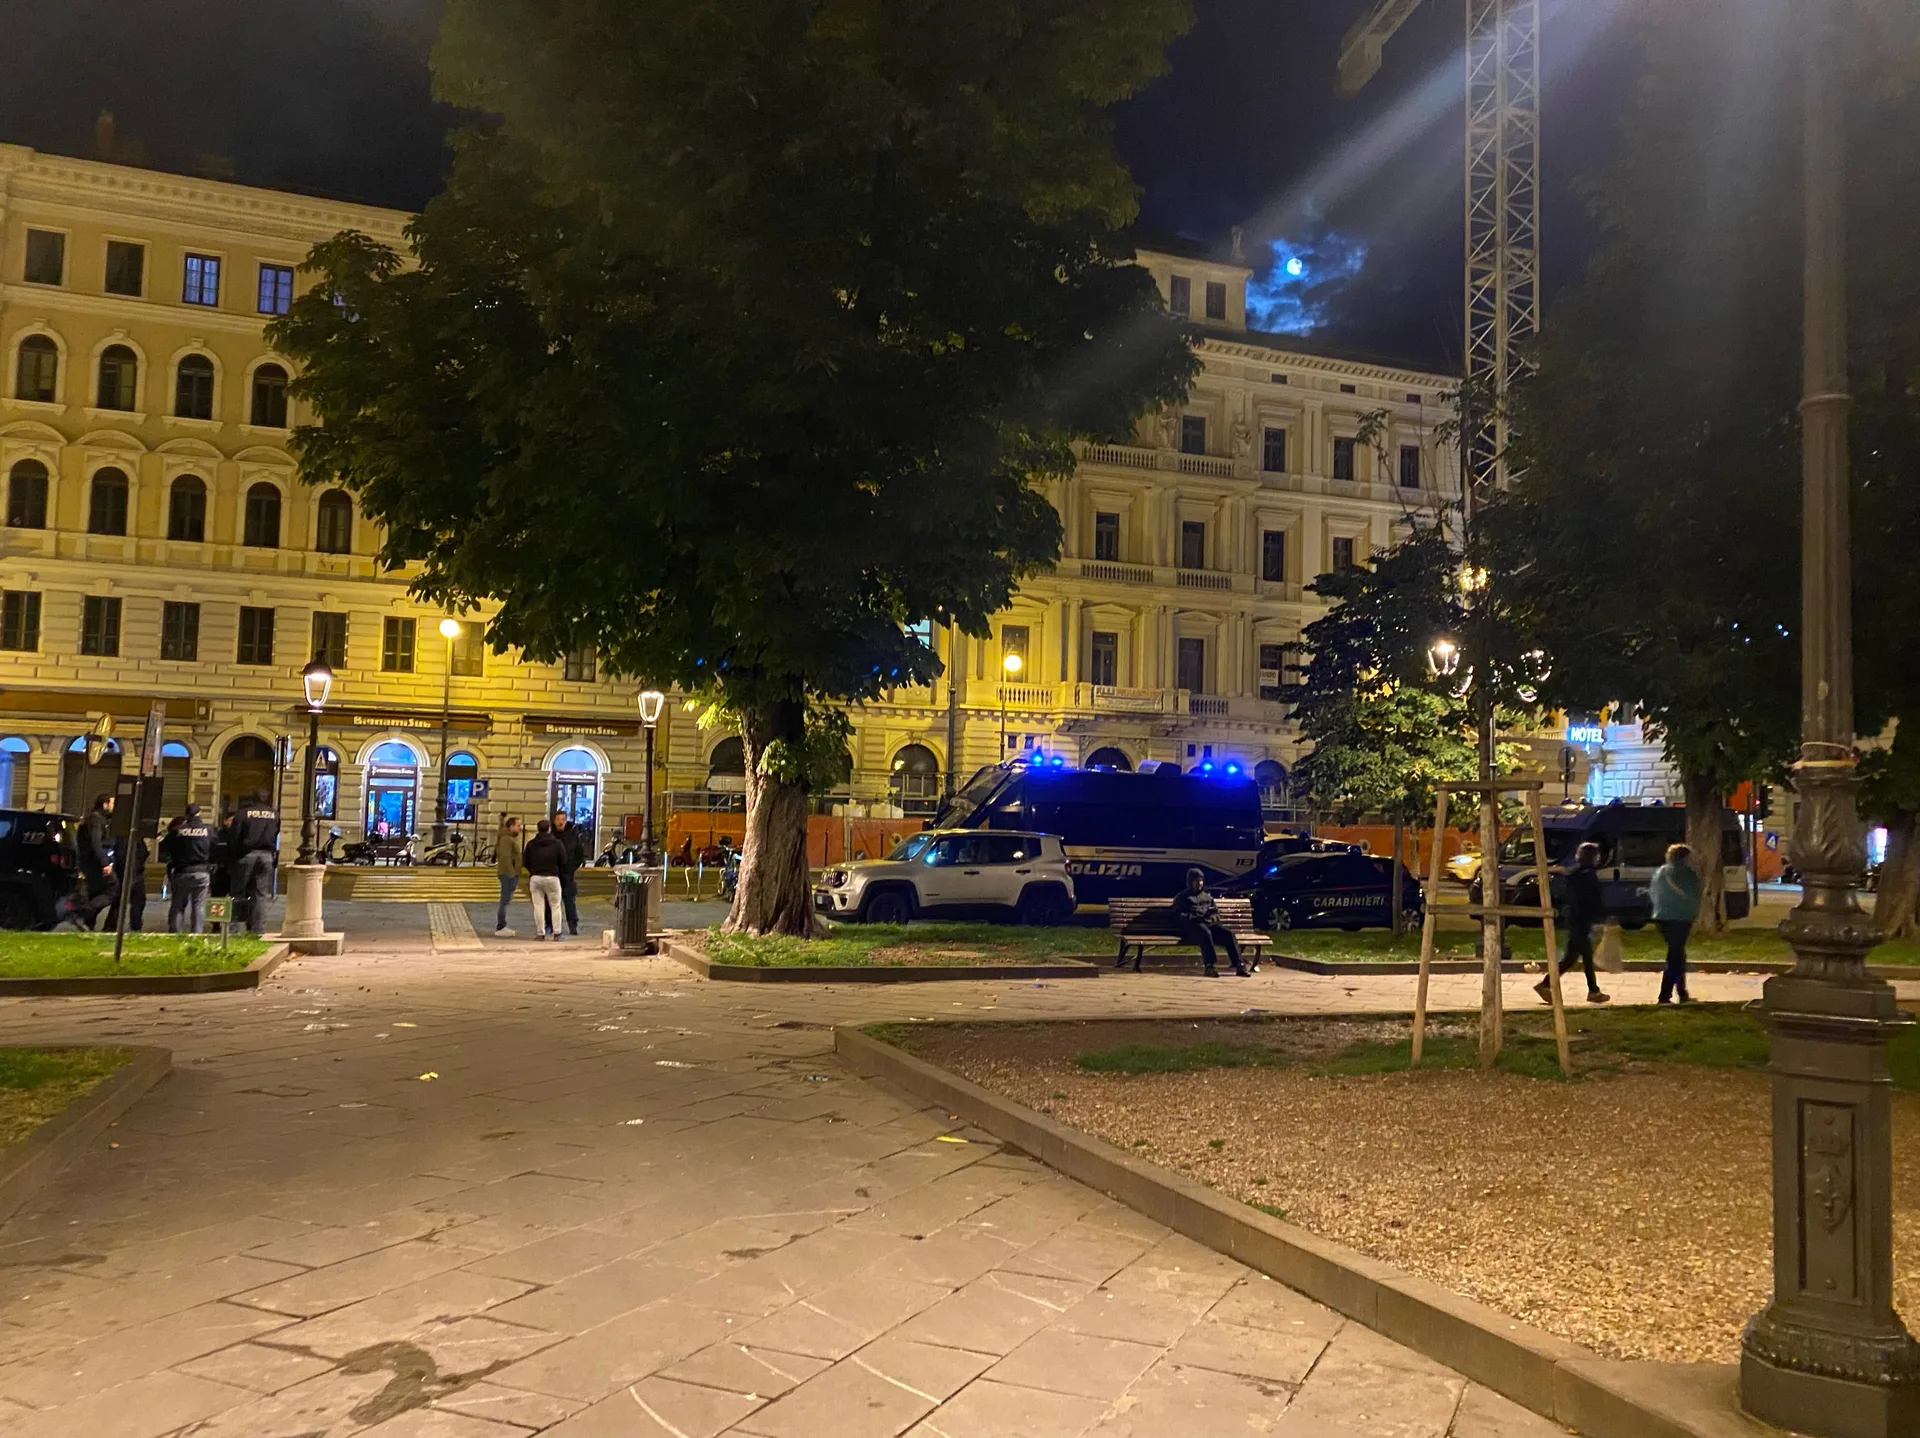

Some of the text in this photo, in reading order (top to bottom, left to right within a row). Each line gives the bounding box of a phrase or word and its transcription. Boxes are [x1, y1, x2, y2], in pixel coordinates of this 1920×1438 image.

[1570, 727, 1604, 742] HOTEL
[472, 781, 485, 796] P
[246, 810, 275, 819] POLIZIA
[179, 827, 208, 837] POLIZIA
[1070, 863, 1142, 876] OLIZIA
[1313, 896, 1385, 907] CARABINIERI
